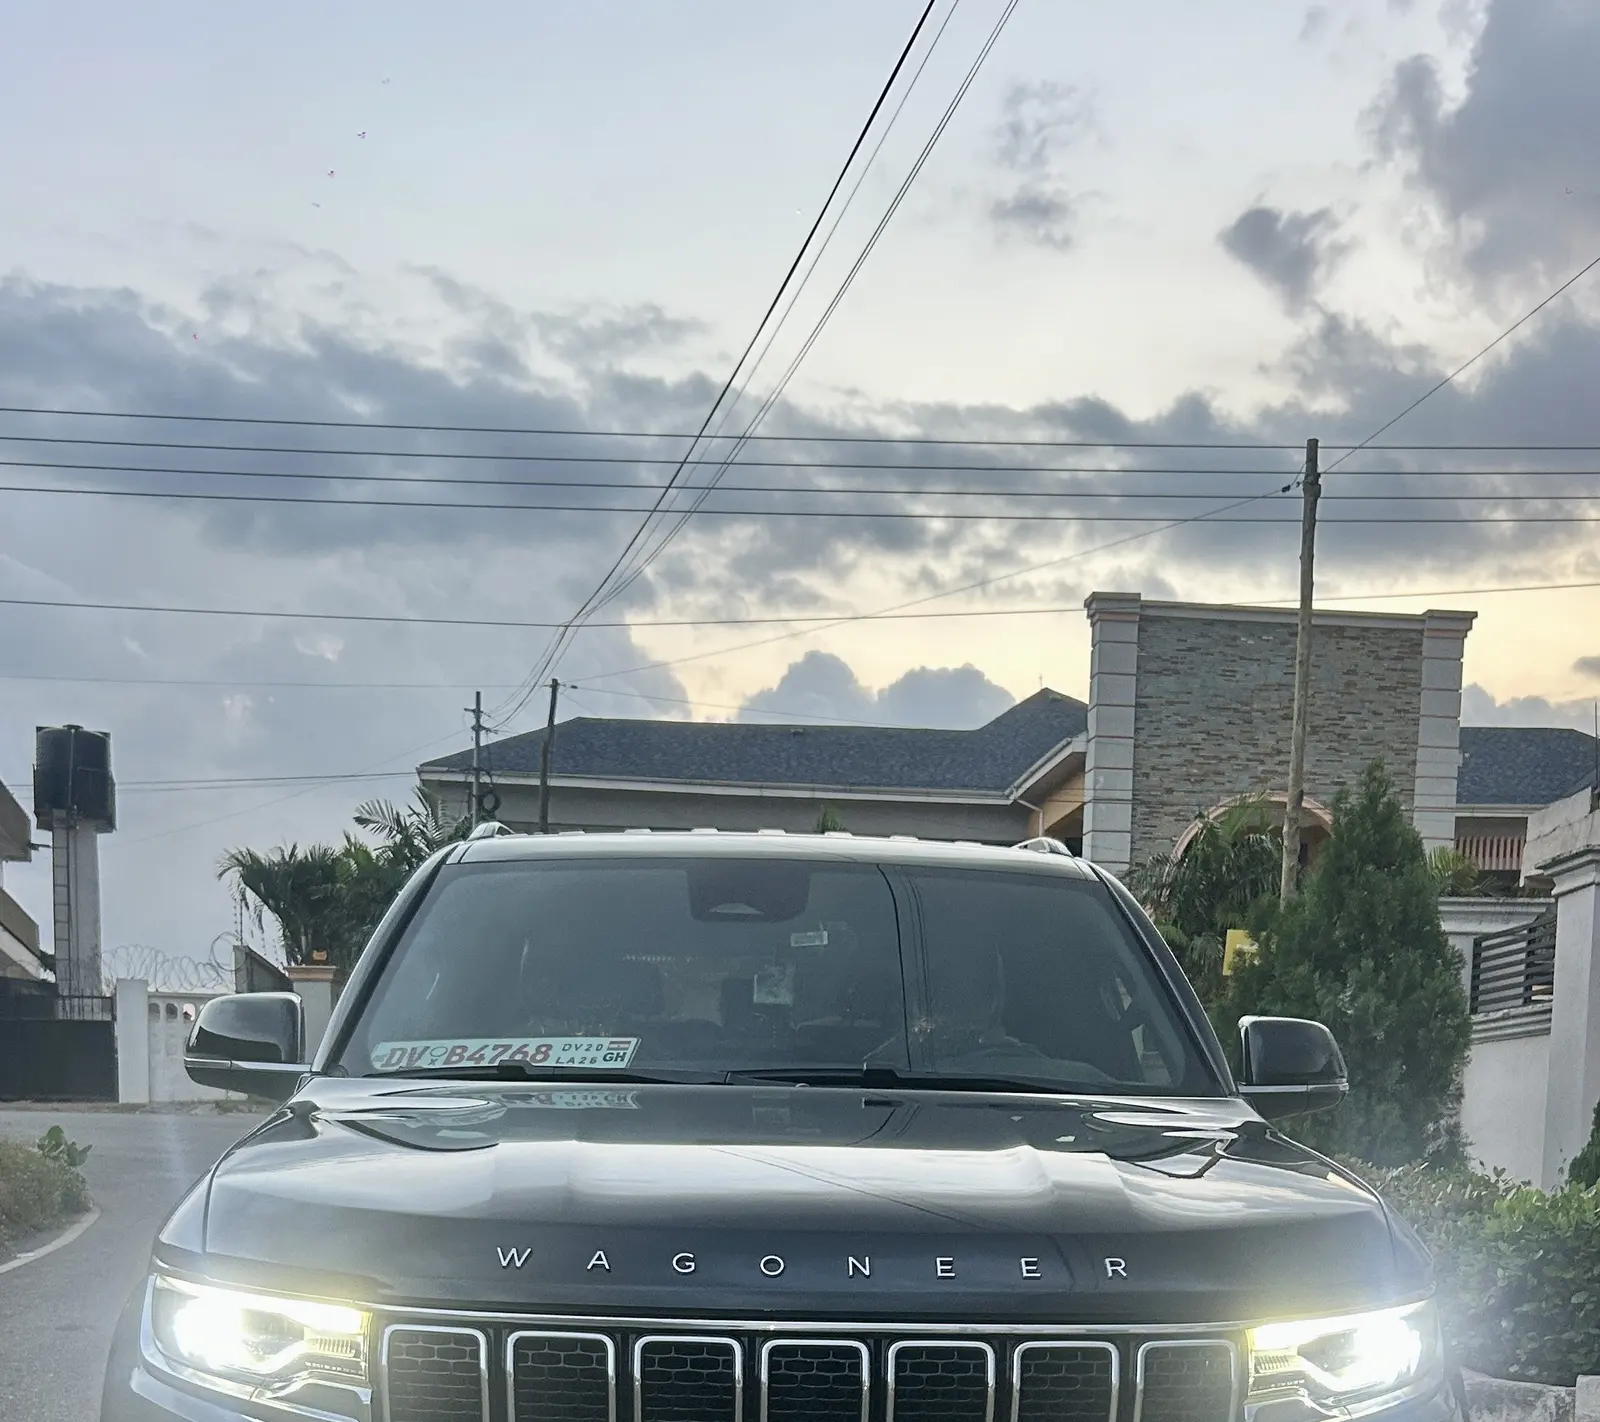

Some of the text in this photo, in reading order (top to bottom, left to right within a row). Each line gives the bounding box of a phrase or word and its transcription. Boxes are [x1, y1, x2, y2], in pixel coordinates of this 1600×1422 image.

[442, 1043, 553, 1065] B4768
[561, 1043, 604, 1052] DV20
[602, 1051, 627, 1062] GH
[496, 1247, 1127, 1278] WAGONEER
